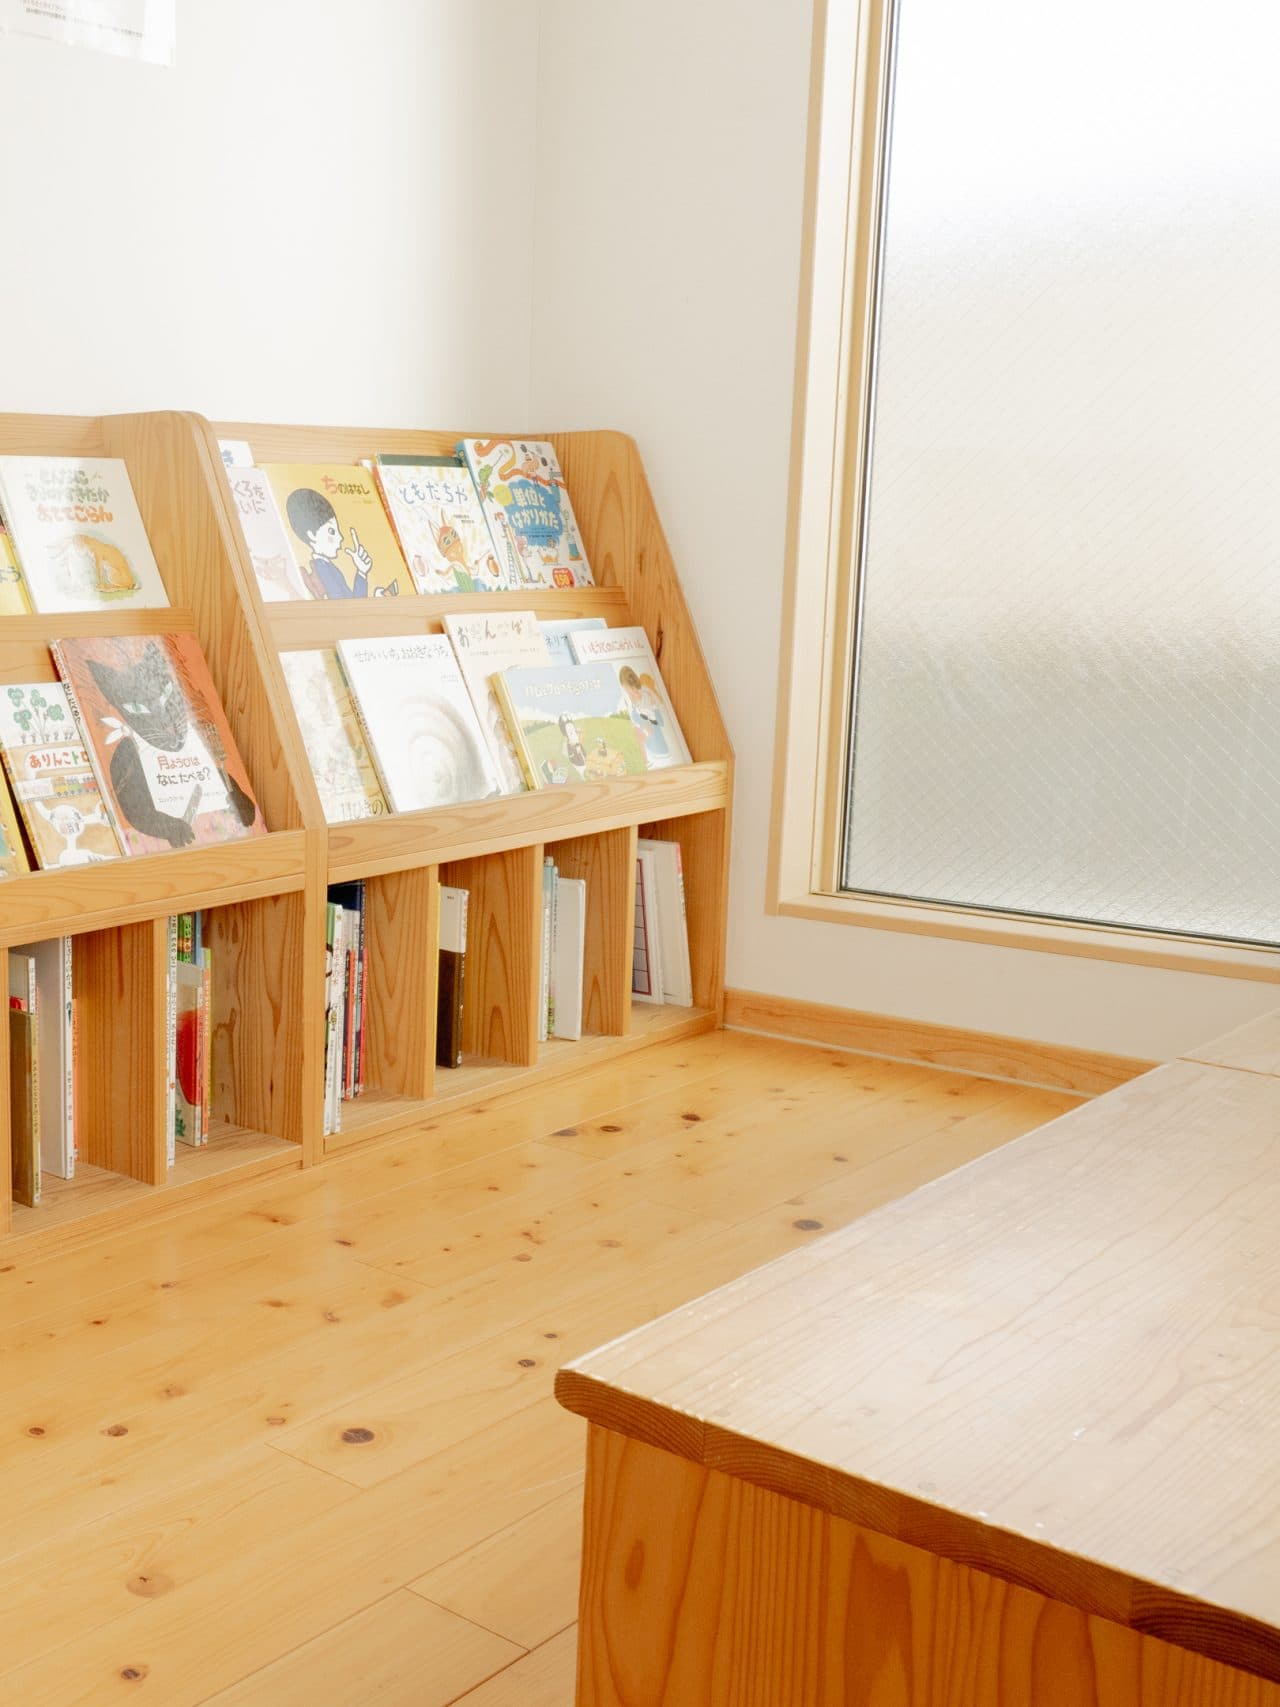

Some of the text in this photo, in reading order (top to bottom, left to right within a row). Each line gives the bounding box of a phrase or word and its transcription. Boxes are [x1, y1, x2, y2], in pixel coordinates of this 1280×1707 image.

[400, 479, 468, 504] ともだちや
